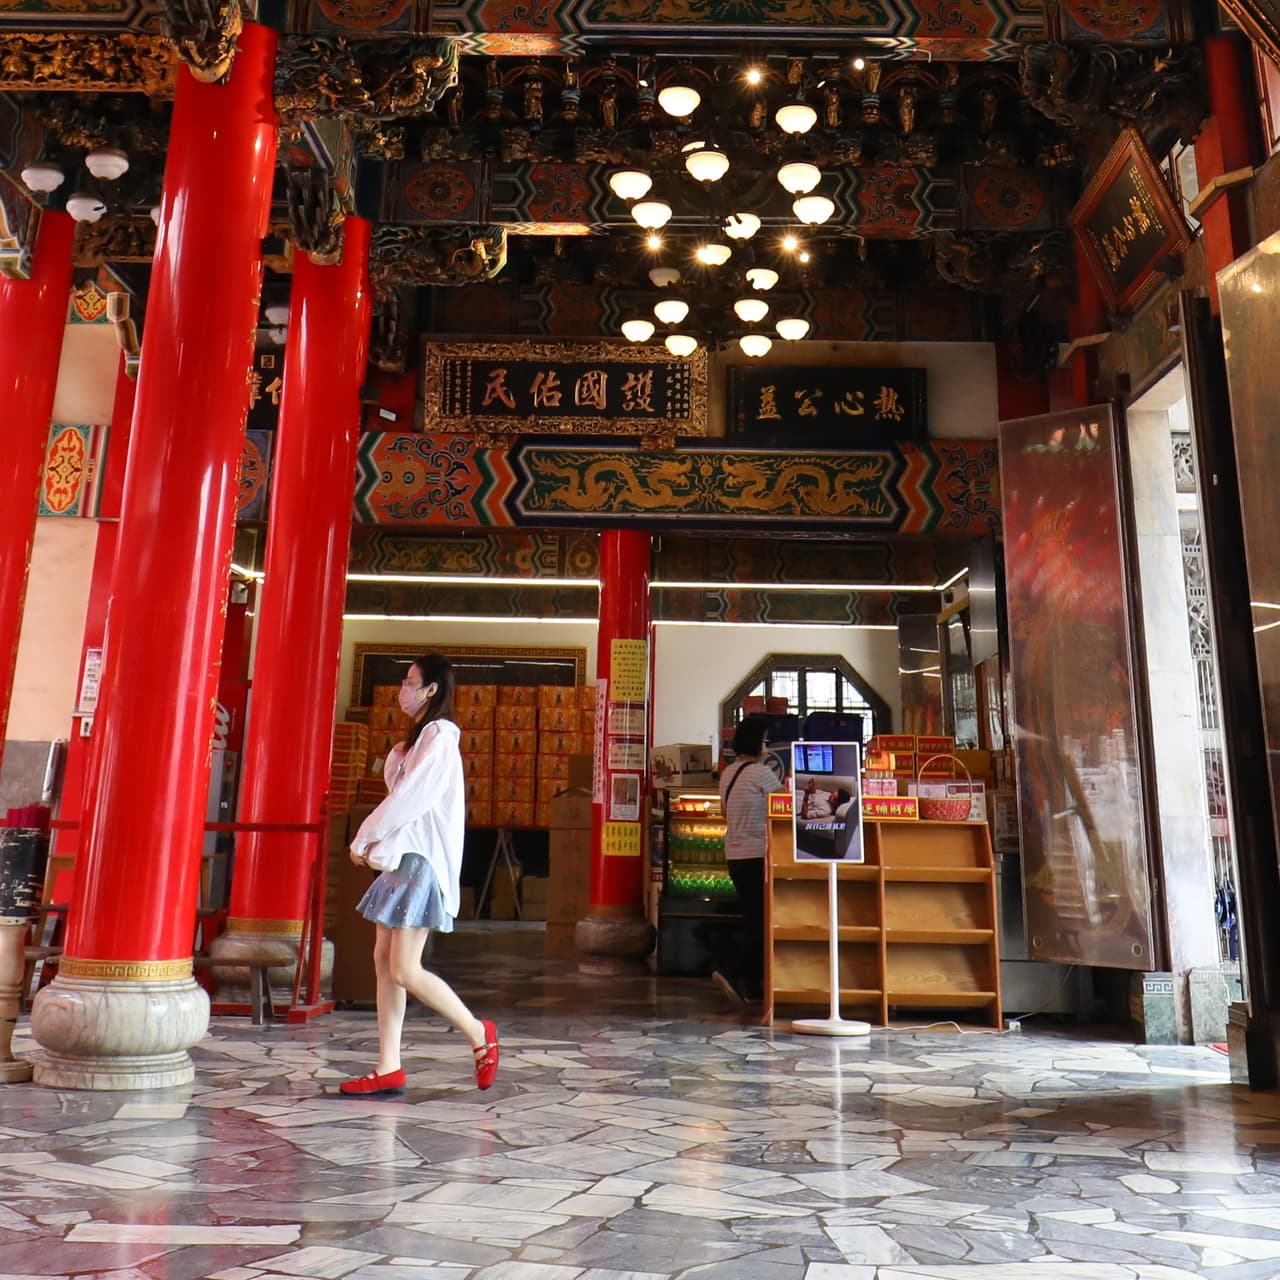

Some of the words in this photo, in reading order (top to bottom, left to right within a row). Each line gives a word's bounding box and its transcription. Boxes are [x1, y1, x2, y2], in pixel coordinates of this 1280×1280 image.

[481, 366, 656, 413] 護國佑民
[756, 385, 906, 420] 熱心公益
